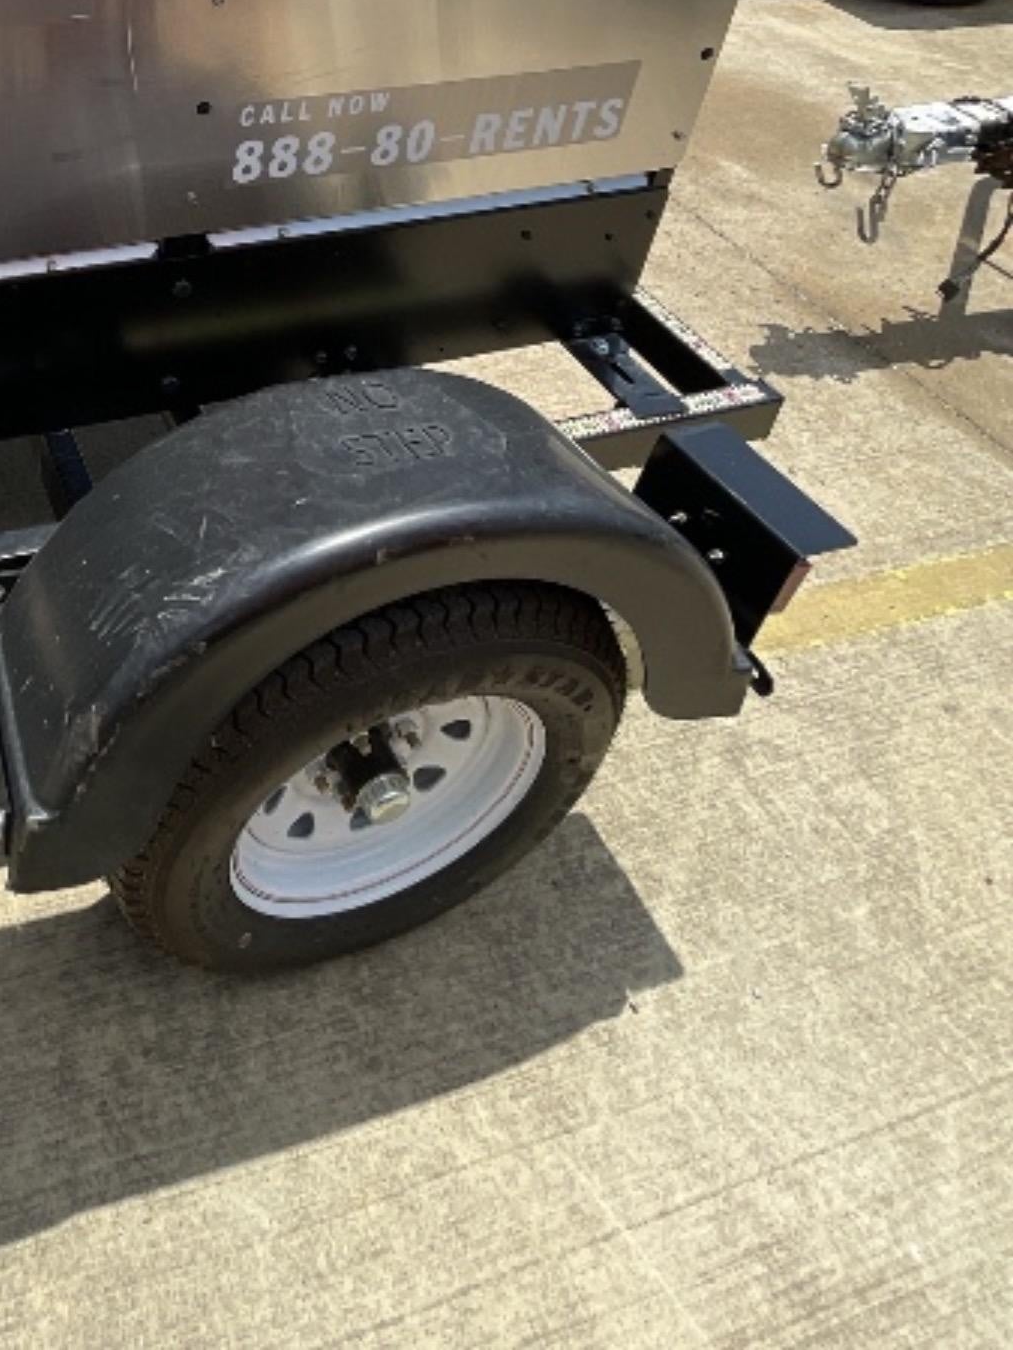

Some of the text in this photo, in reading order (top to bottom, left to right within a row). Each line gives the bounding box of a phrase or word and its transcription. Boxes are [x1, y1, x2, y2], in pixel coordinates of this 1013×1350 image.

[240, 92, 390, 127] CALL NOW
[232, 98, 625, 184] 888-80-RENTS
